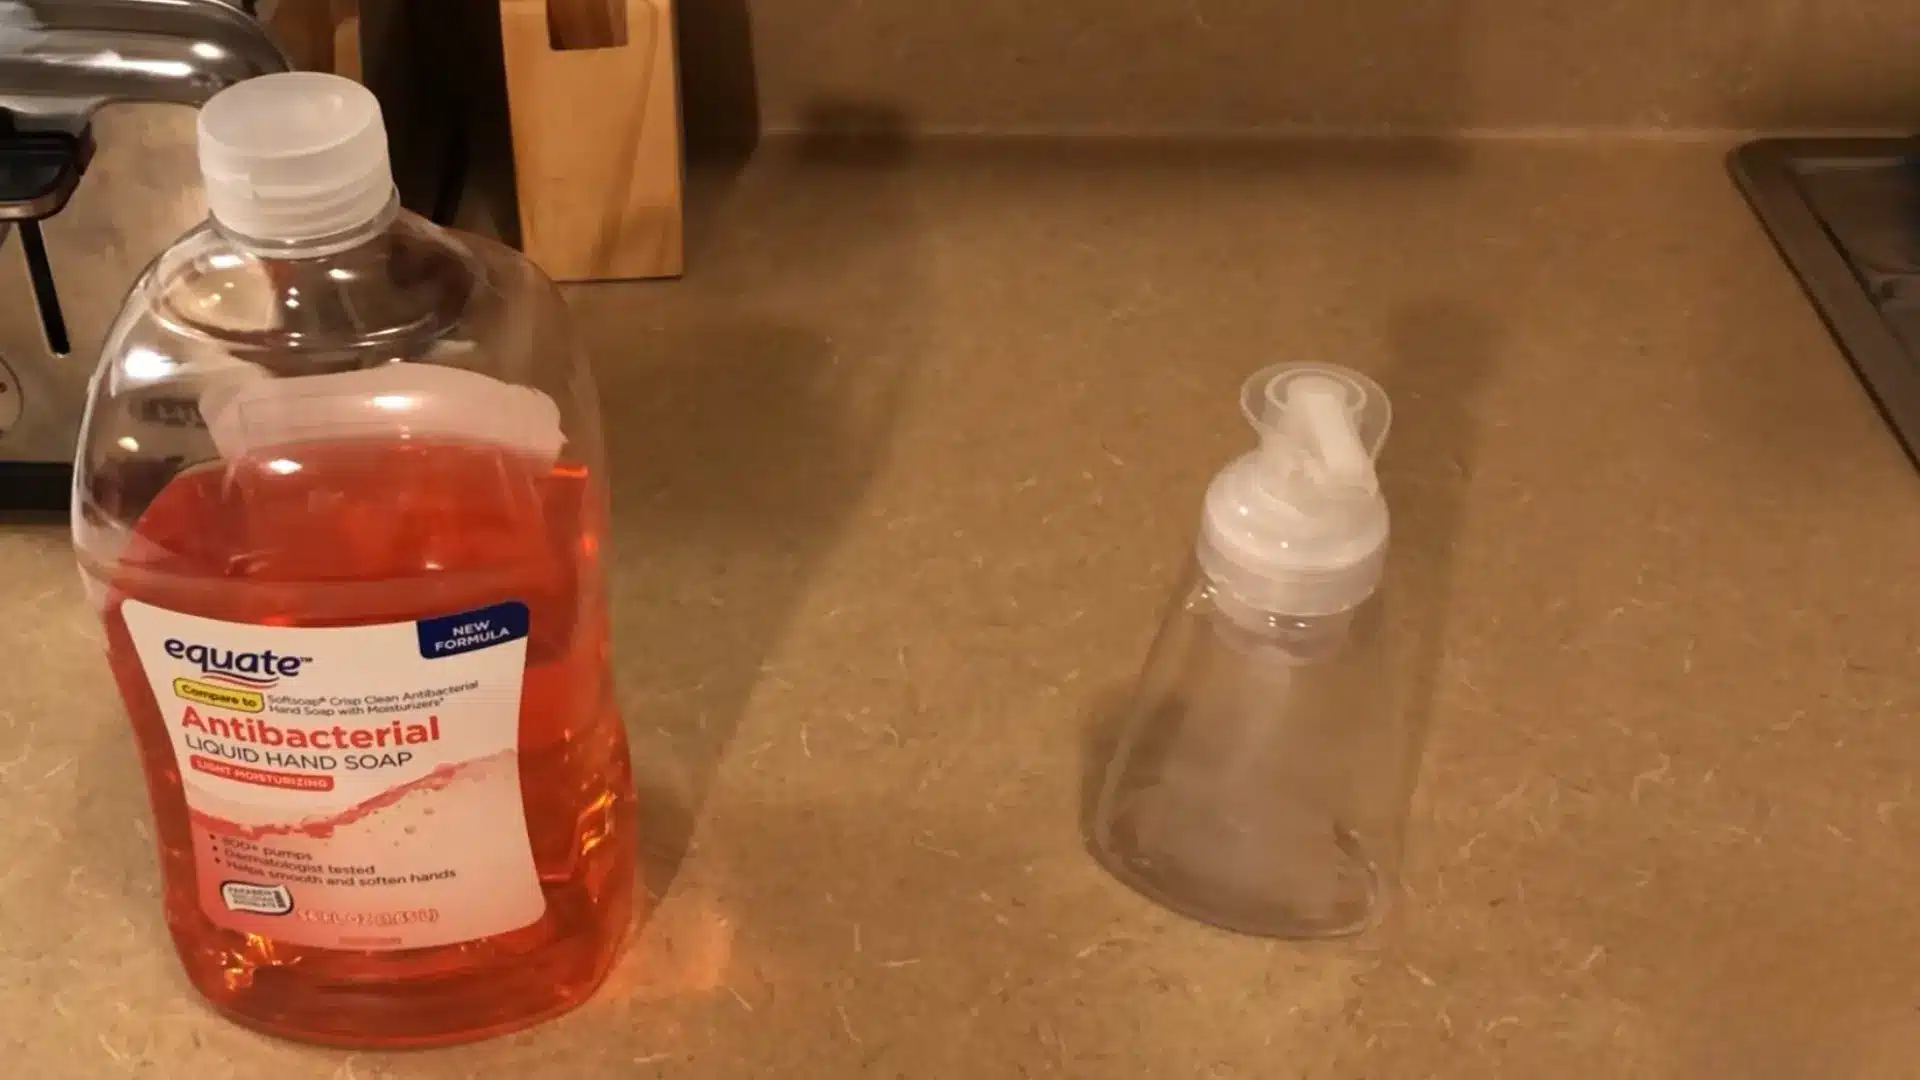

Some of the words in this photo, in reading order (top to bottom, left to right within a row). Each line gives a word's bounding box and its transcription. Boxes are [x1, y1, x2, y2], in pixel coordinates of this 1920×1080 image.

[435, 627, 510, 652] FORMULA
[452, 620, 490, 637] NEW
[181, 684, 239, 705] Compare
[242, 697, 257, 707] to
[364, 695, 400, 704] Clean
[402, 680, 479, 701] Antibacterial
[269, 703, 301, 715] Hand
[303, 707, 335, 717] Soap
[337, 706, 365, 715] with
[180, 705, 441, 750] Antibacterial
[184, 733, 261, 763] LIQUID
[265, 751, 337, 770] HAND
[343, 751, 413, 770] SOAP
[224, 847, 323, 874] Dermatologist
[327, 865, 376, 875] tested
[262, 847, 313, 861] pumps
[268, 871, 324, 884] smooth
[326, 878, 355, 886] and
[358, 876, 407, 887] soften
[409, 869, 457, 884] hands
